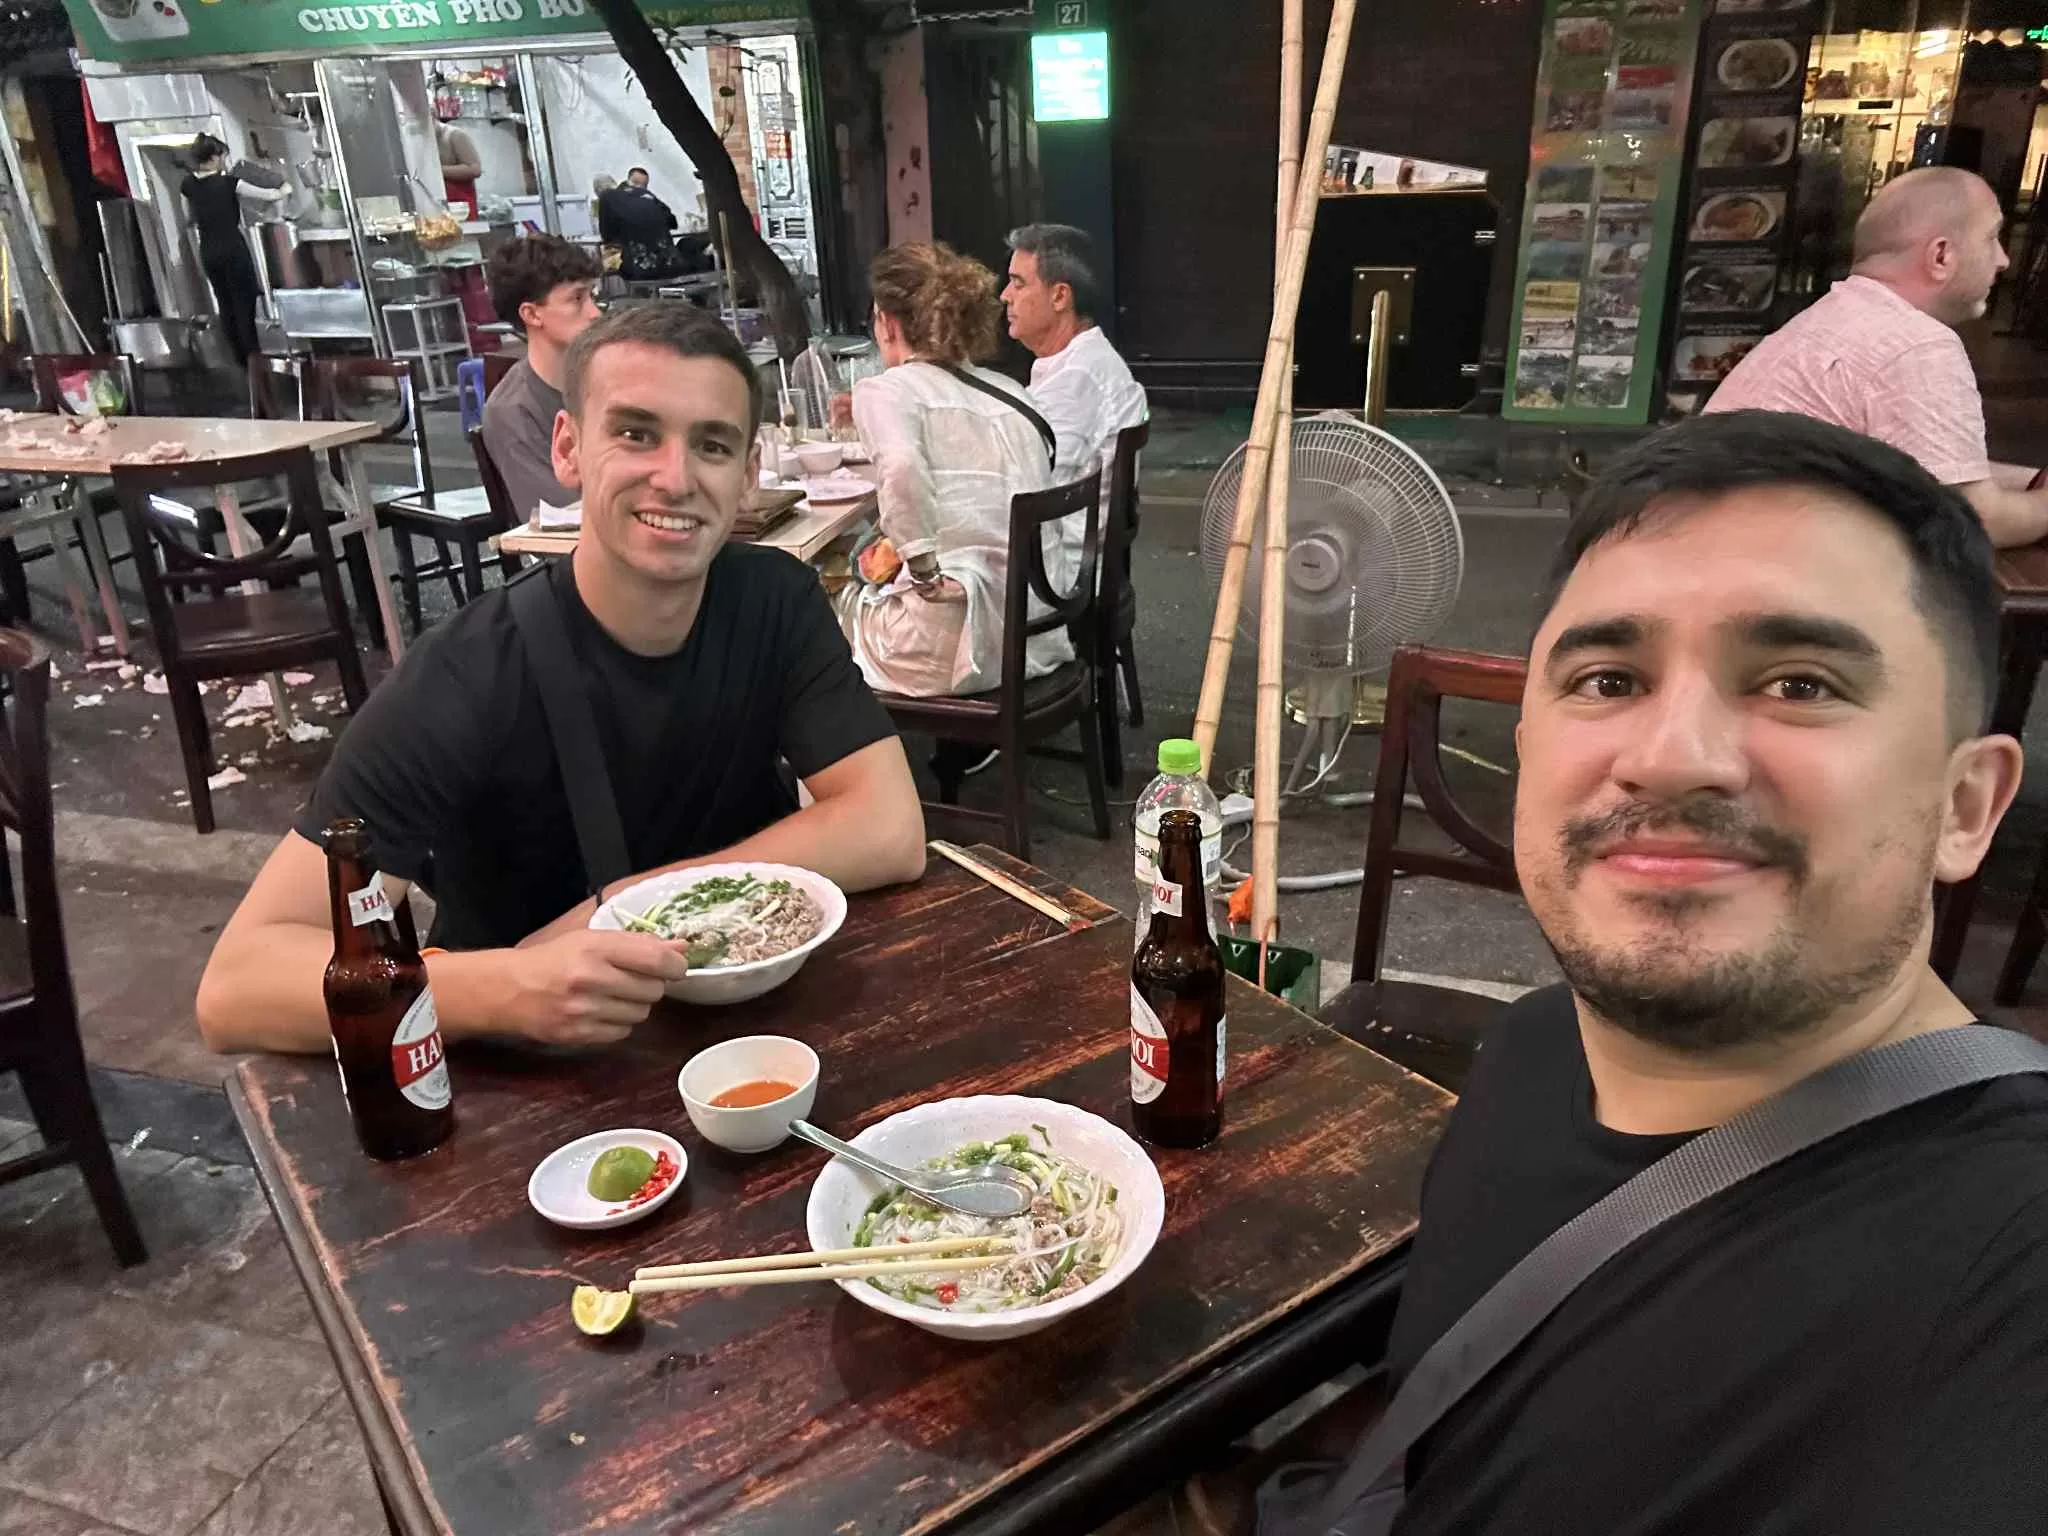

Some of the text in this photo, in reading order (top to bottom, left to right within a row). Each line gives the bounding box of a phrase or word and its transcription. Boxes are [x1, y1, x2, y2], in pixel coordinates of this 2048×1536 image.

[1061, 4, 1081, 24] 27
[360, 889, 386, 912] HA
[408, 1033, 442, 1075] HA
